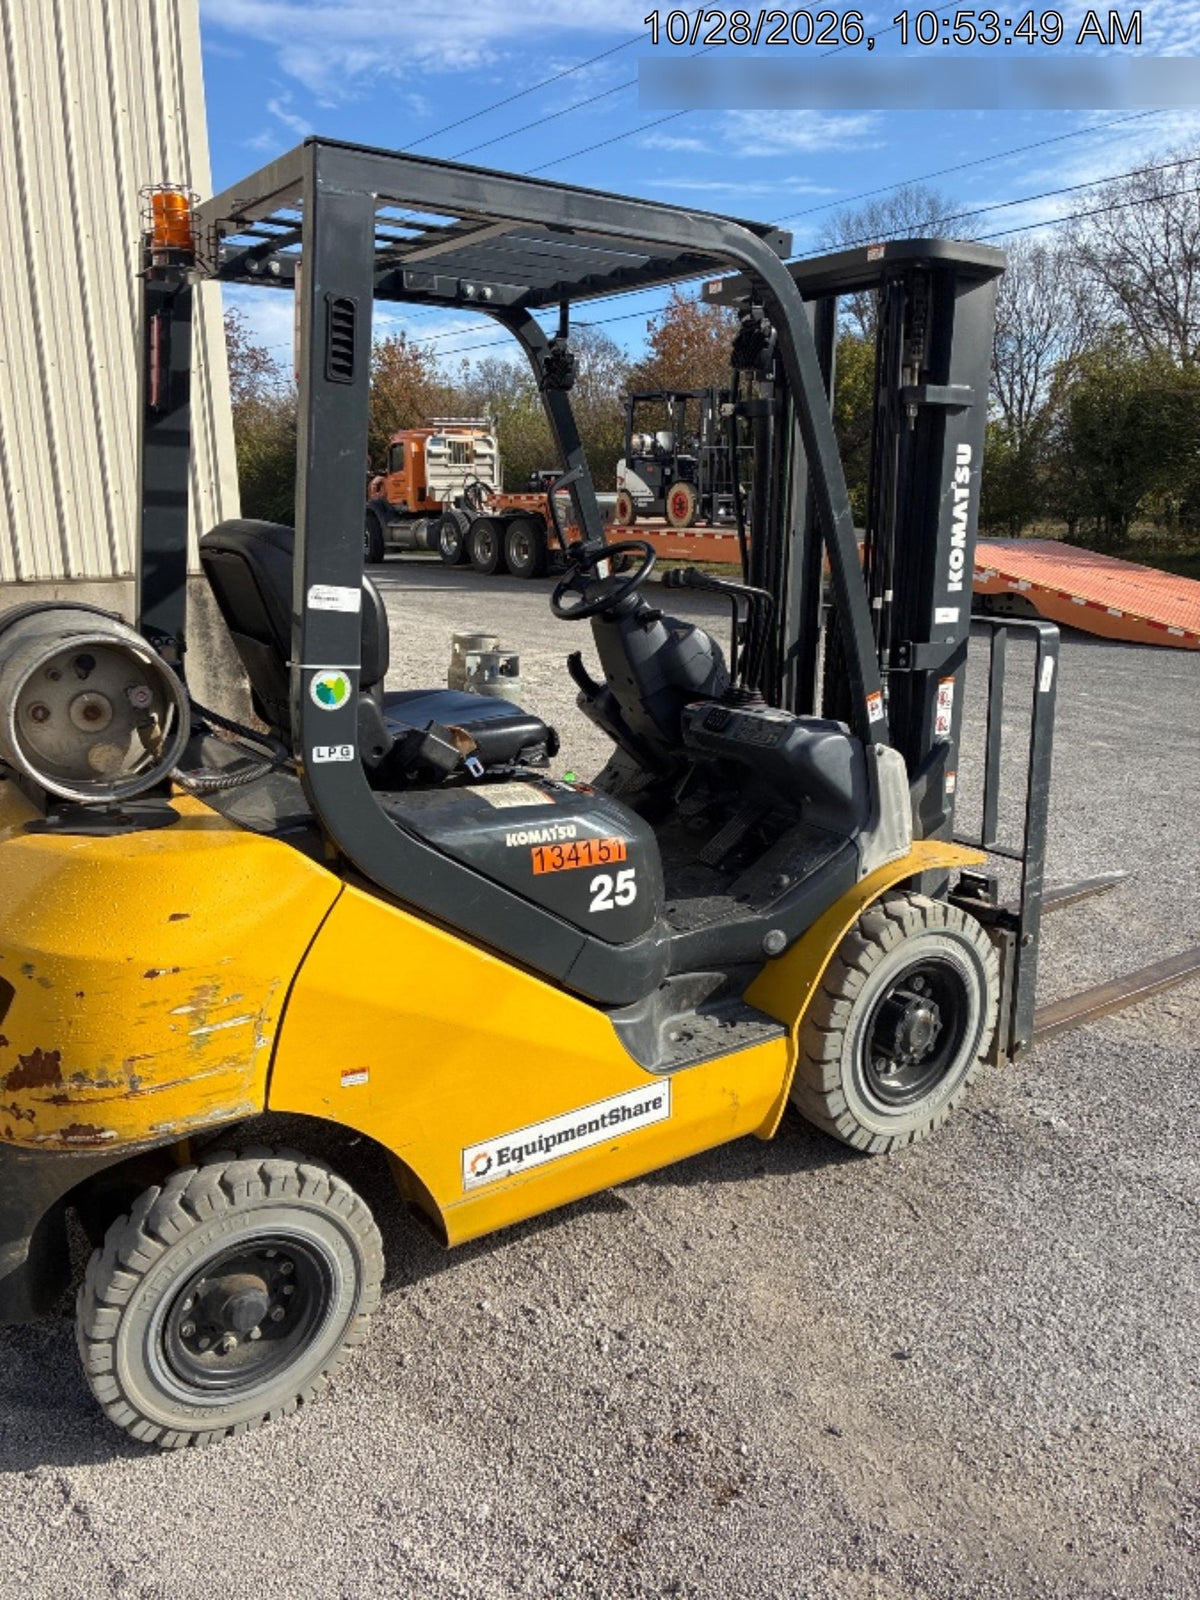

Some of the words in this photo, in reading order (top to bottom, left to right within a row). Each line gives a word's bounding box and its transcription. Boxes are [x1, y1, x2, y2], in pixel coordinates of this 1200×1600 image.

[947, 443, 972, 592] KOMATSU
[505, 823, 577, 847] KOMATSU
[534, 840, 622, 872] 134151
[589, 867, 637, 913] 25
[496, 1095, 663, 1167] EquipmentShare
